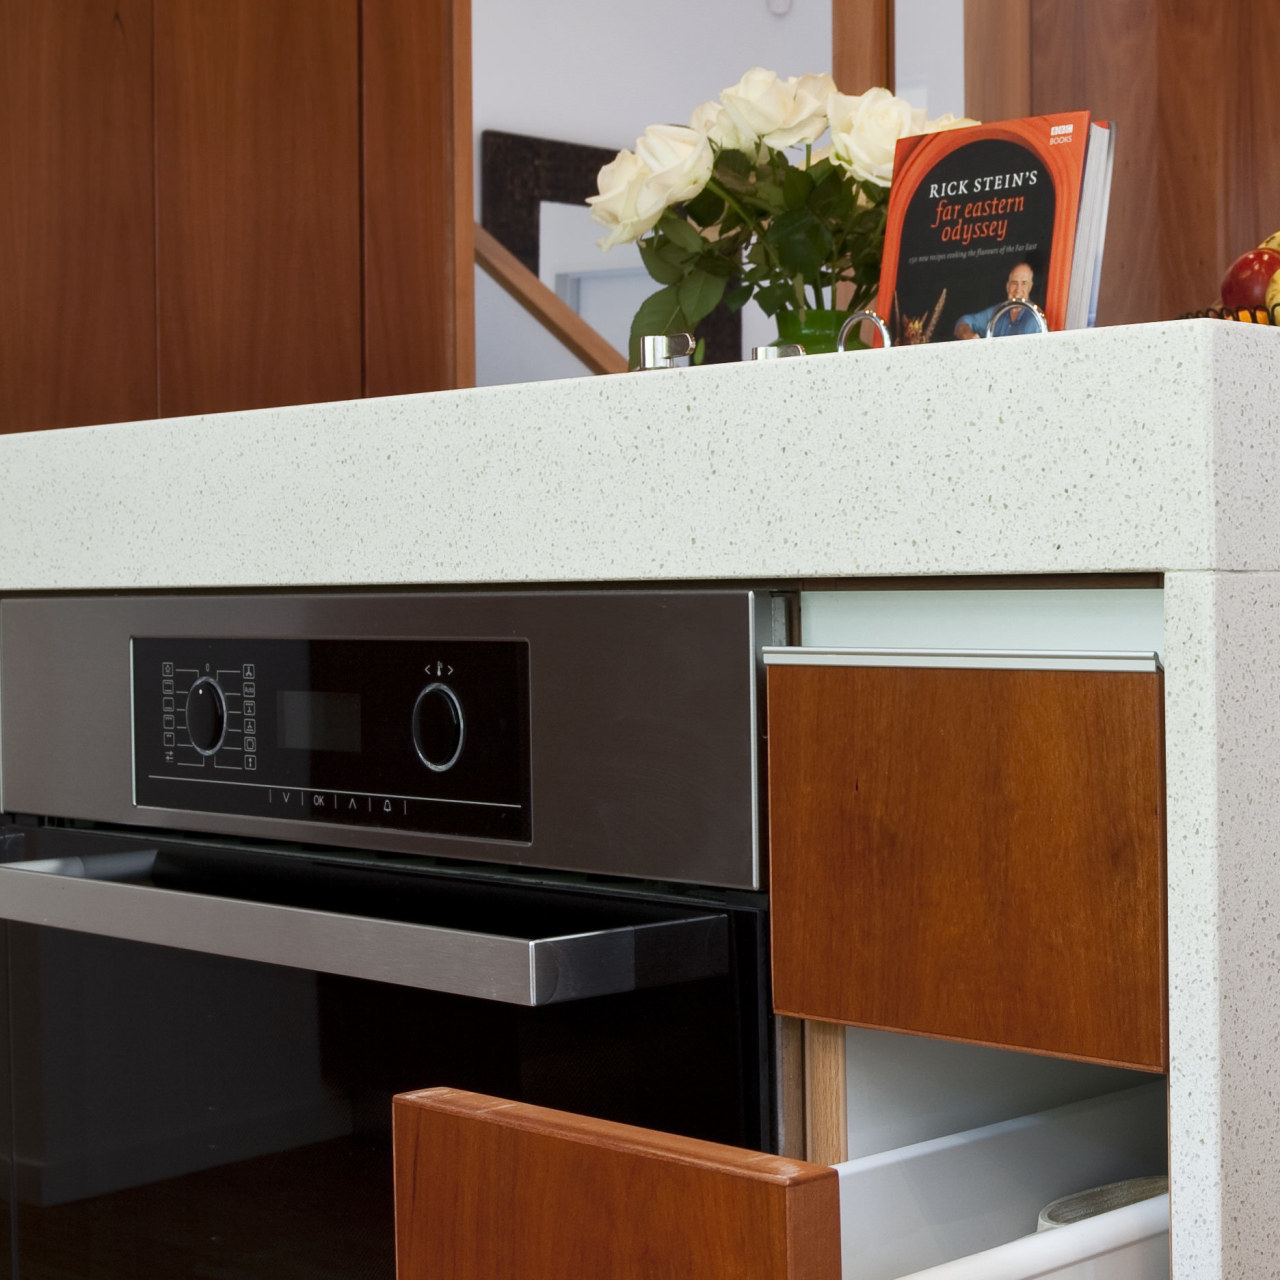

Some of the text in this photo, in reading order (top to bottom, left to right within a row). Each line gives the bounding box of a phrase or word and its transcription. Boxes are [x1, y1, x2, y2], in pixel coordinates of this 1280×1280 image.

[1050, 135, 1072, 145] BOOKS
[929, 170, 1038, 198] RICK STEIN'S
[931, 196, 1025, 228] far eastern
[941, 219, 1008, 245] odyssey
[967, 248, 977, 257] the
[975, 247, 999, 258] flavours
[999, 245, 1007, 256] of
[1006, 244, 1015, 253] the
[1015, 243, 1025, 253] Far
[1025, 243, 1038, 251] East
[313, 794, 325, 806] OK
